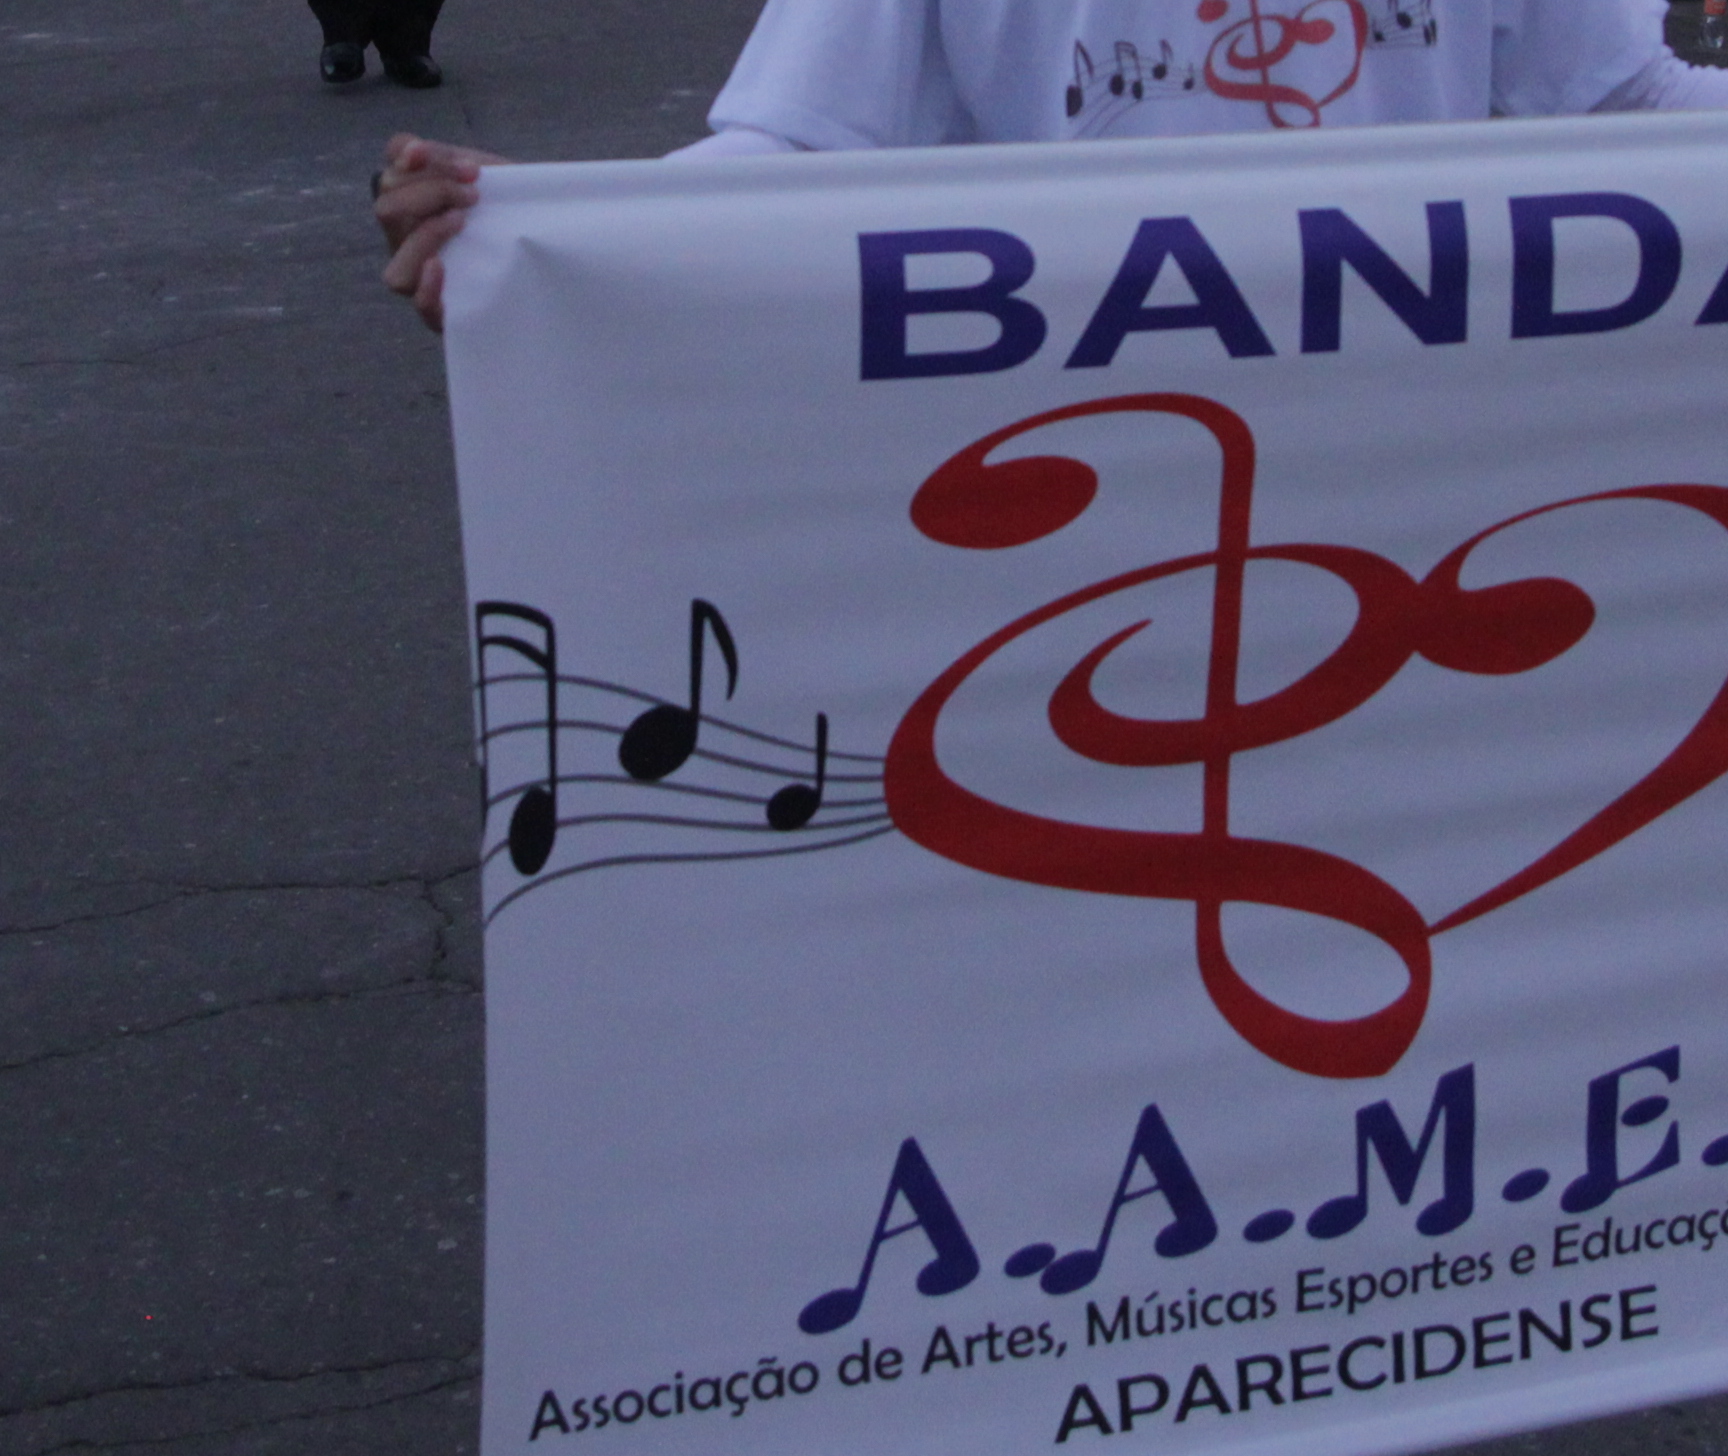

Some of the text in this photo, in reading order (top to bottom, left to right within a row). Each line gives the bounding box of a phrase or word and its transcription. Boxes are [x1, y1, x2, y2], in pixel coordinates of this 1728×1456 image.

[529, 1356, 820, 1442] Associação
[838, 1339, 904, 1386] de
[921, 1321, 1067, 1374] Artes,
[1086, 1286, 1277, 1347] Músicas
[1295, 1250, 1494, 1314] Esportes
[1510, 1243, 1536, 1275] e
[1055, 1284, 1660, 1444] APARECIDENSE
